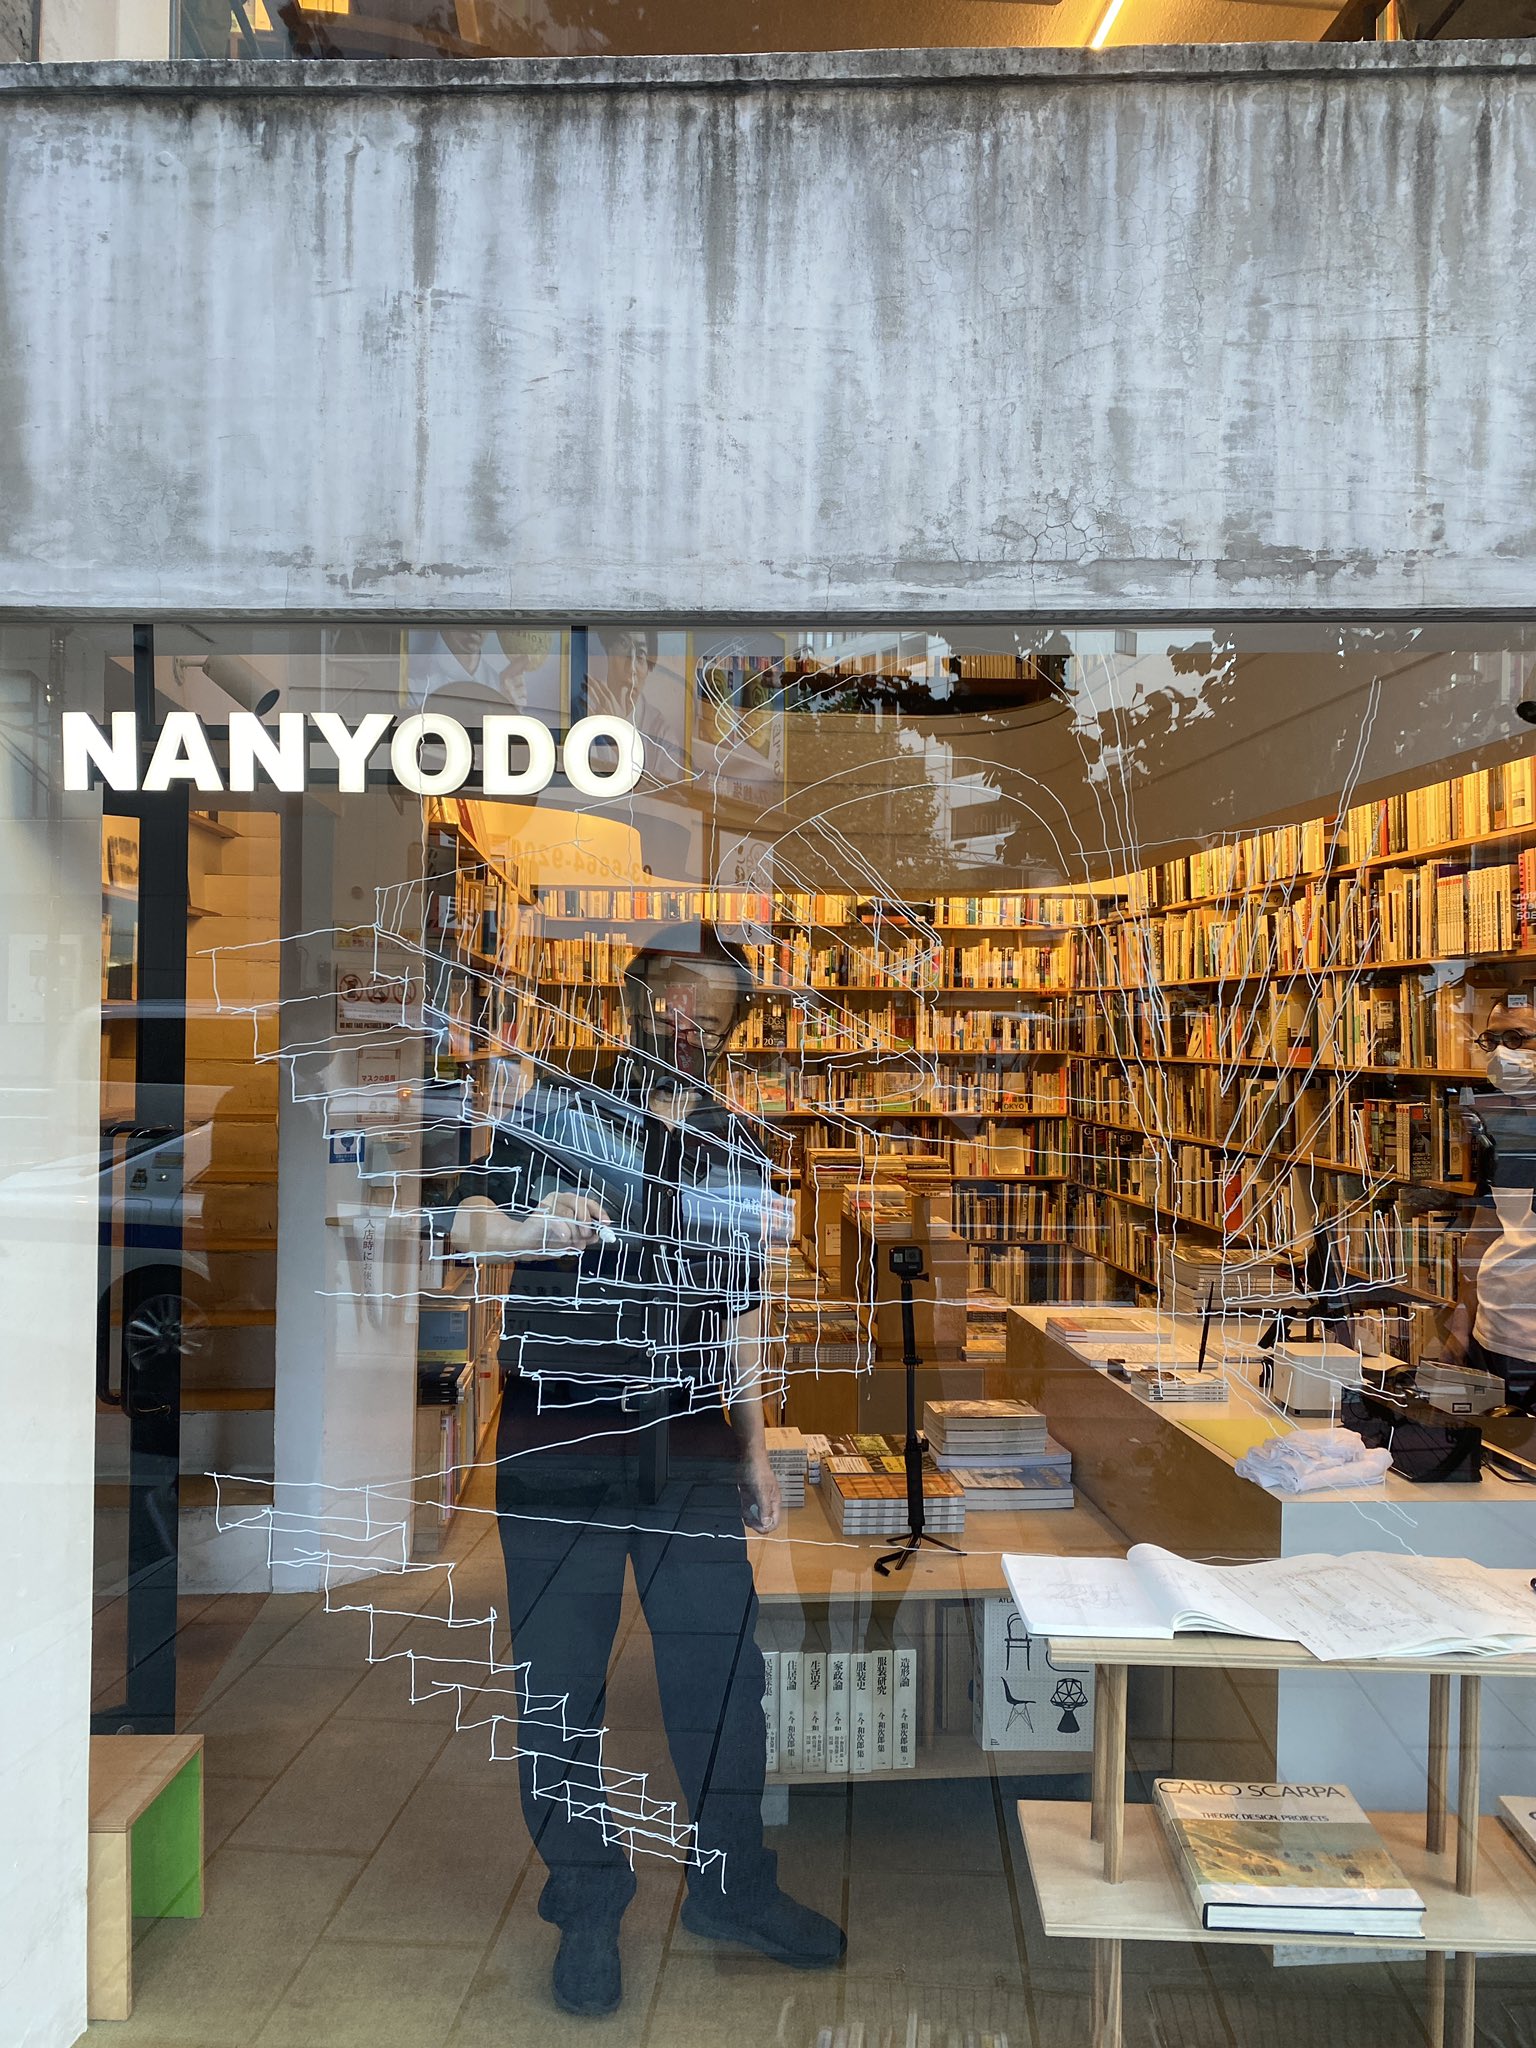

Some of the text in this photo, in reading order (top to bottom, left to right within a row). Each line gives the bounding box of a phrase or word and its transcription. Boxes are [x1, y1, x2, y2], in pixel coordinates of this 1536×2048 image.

[62, 712, 645, 797] NANYODO
[810, 1660, 821, 1691] 生活学
[833, 1660, 843, 1691] 家政論
[856, 1661, 867, 1691] 服装史
[876, 1656, 887, 1696] 服装研究
[900, 1657, 910, 1688] 造形論
[856, 1717, 865, 1758] 今和次郎集
[877, 1712, 886, 1753] 今和次郎集
[1158, 1781, 1346, 1799] CARLO SCARPA
[1281, 1814, 1329, 1822] PROJECTS
